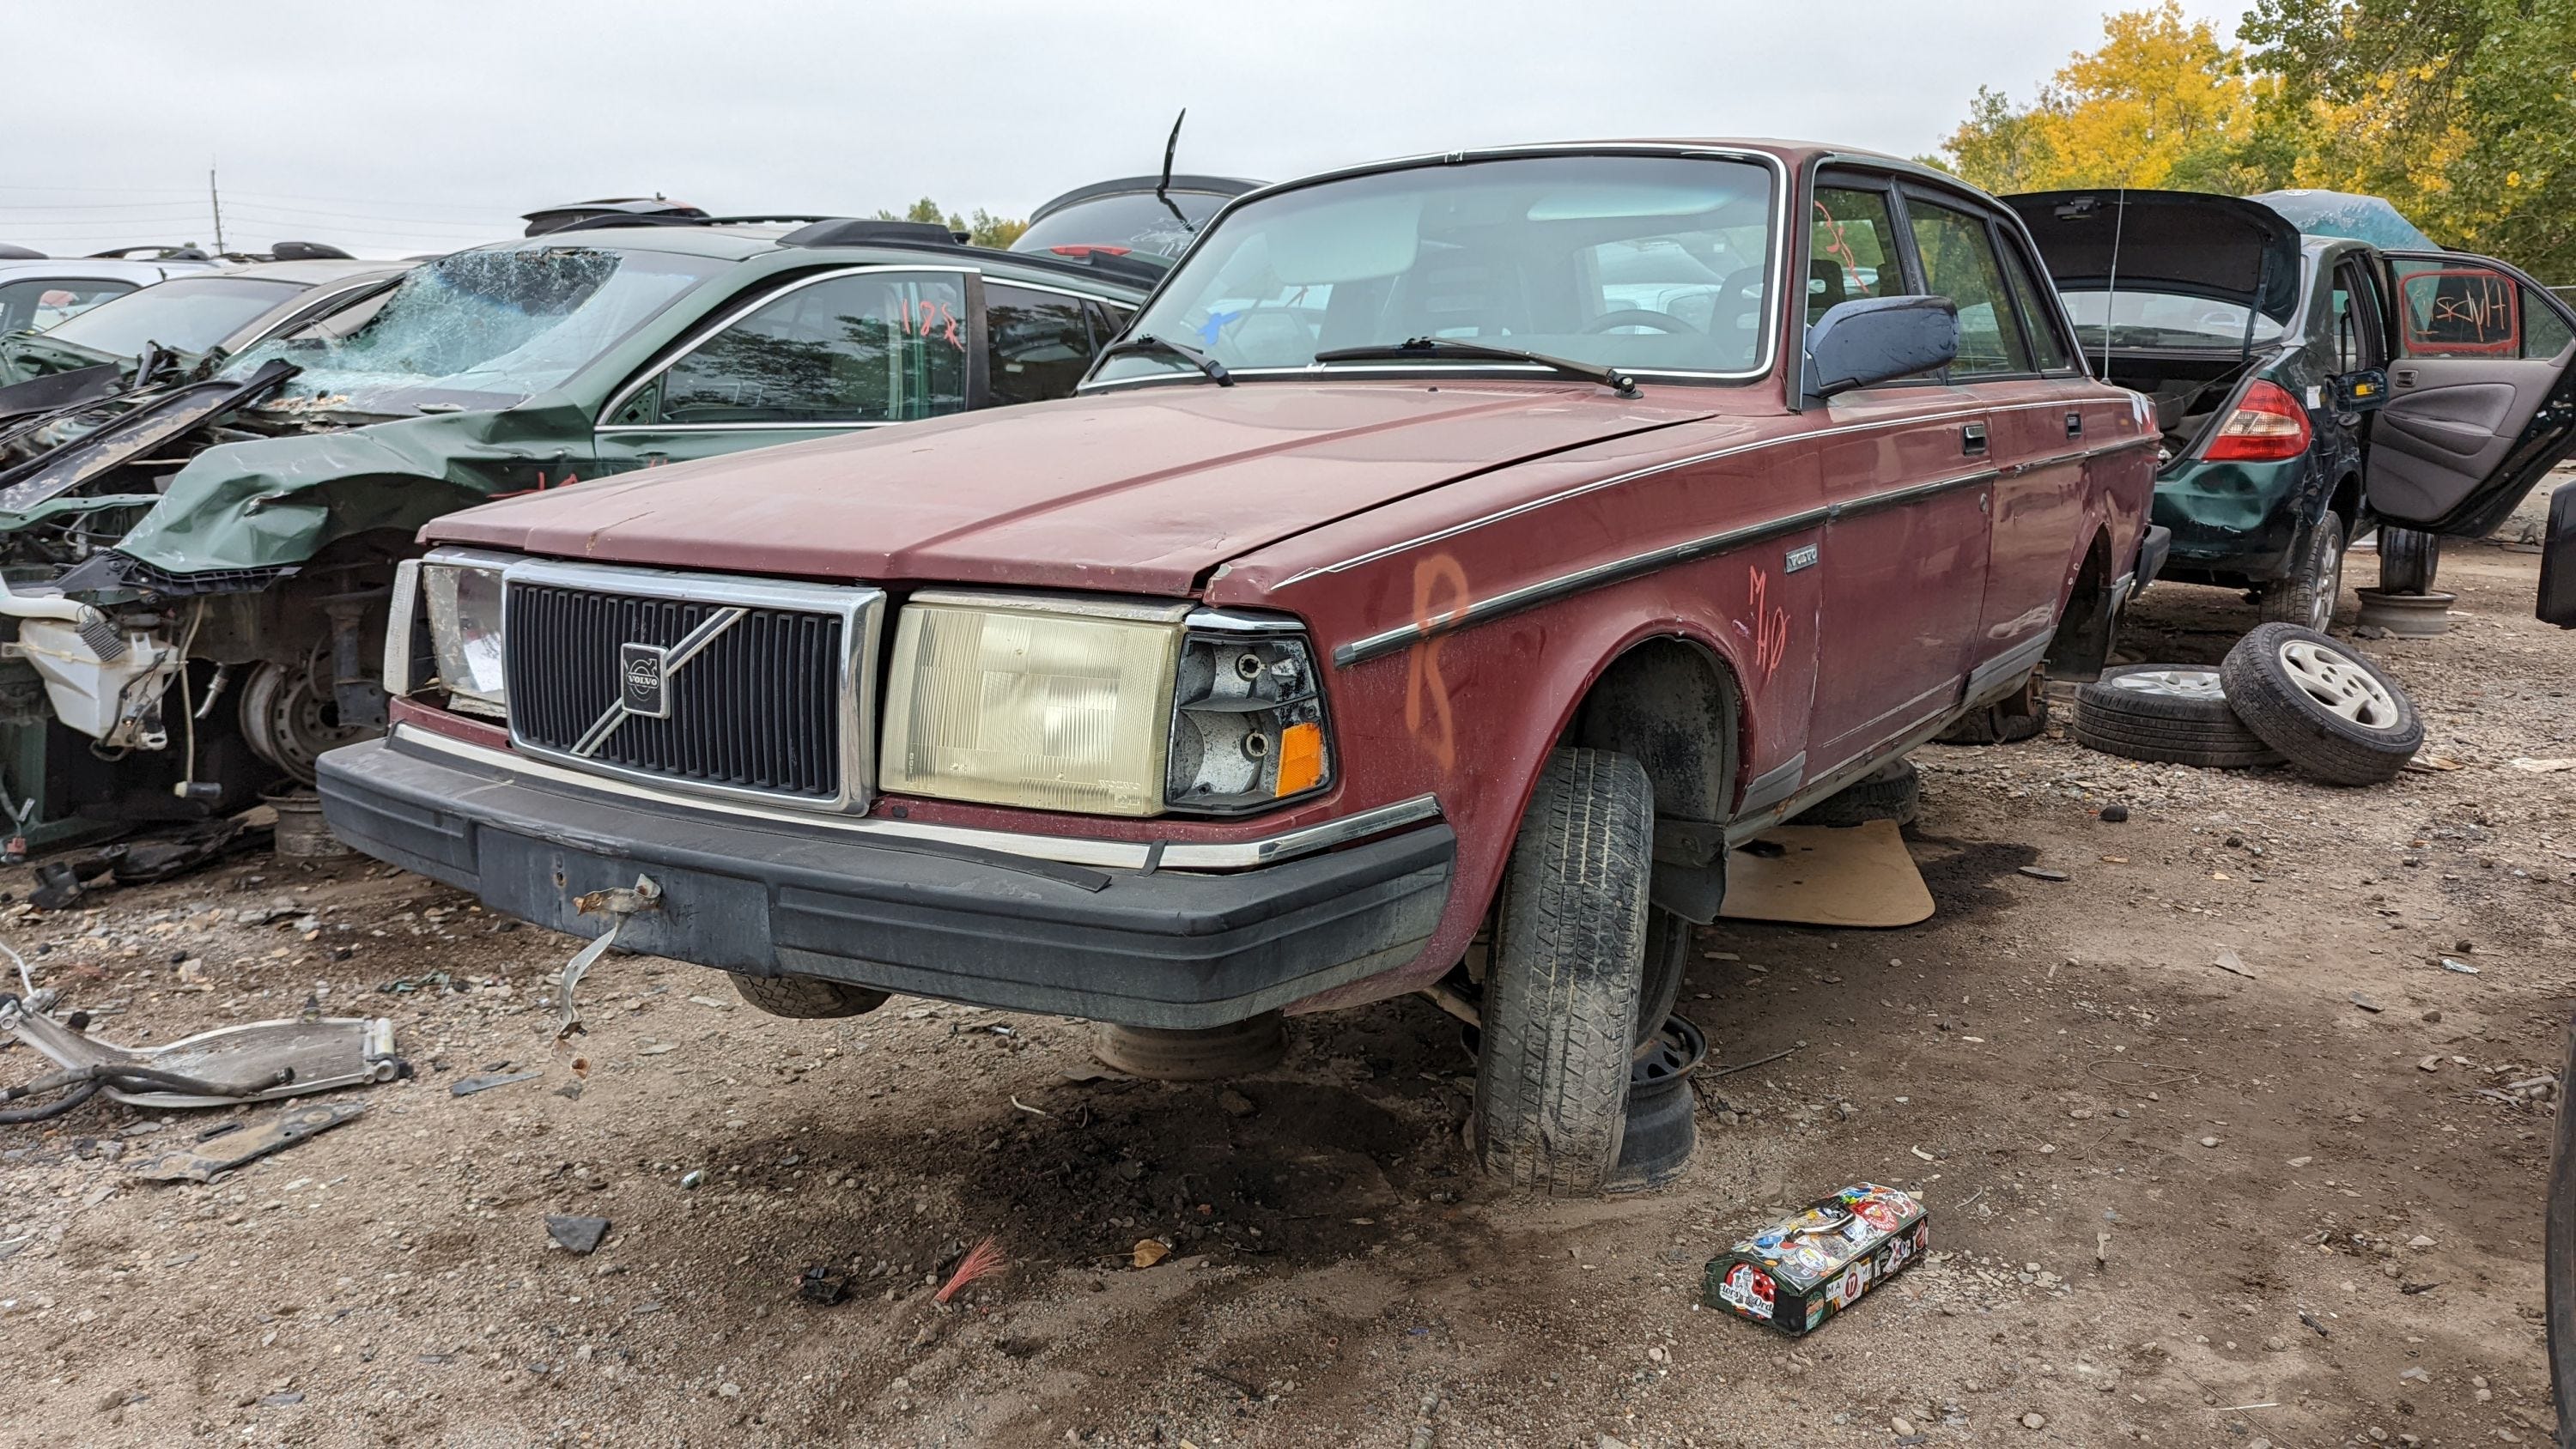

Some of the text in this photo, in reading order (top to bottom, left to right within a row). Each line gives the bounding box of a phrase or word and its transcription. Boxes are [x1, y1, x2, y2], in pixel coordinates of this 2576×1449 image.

[628, 675, 658, 686] VOLVO
[1099, 779, 1141, 790] VOLVO
[1848, 1275, 1856, 1295] 17
